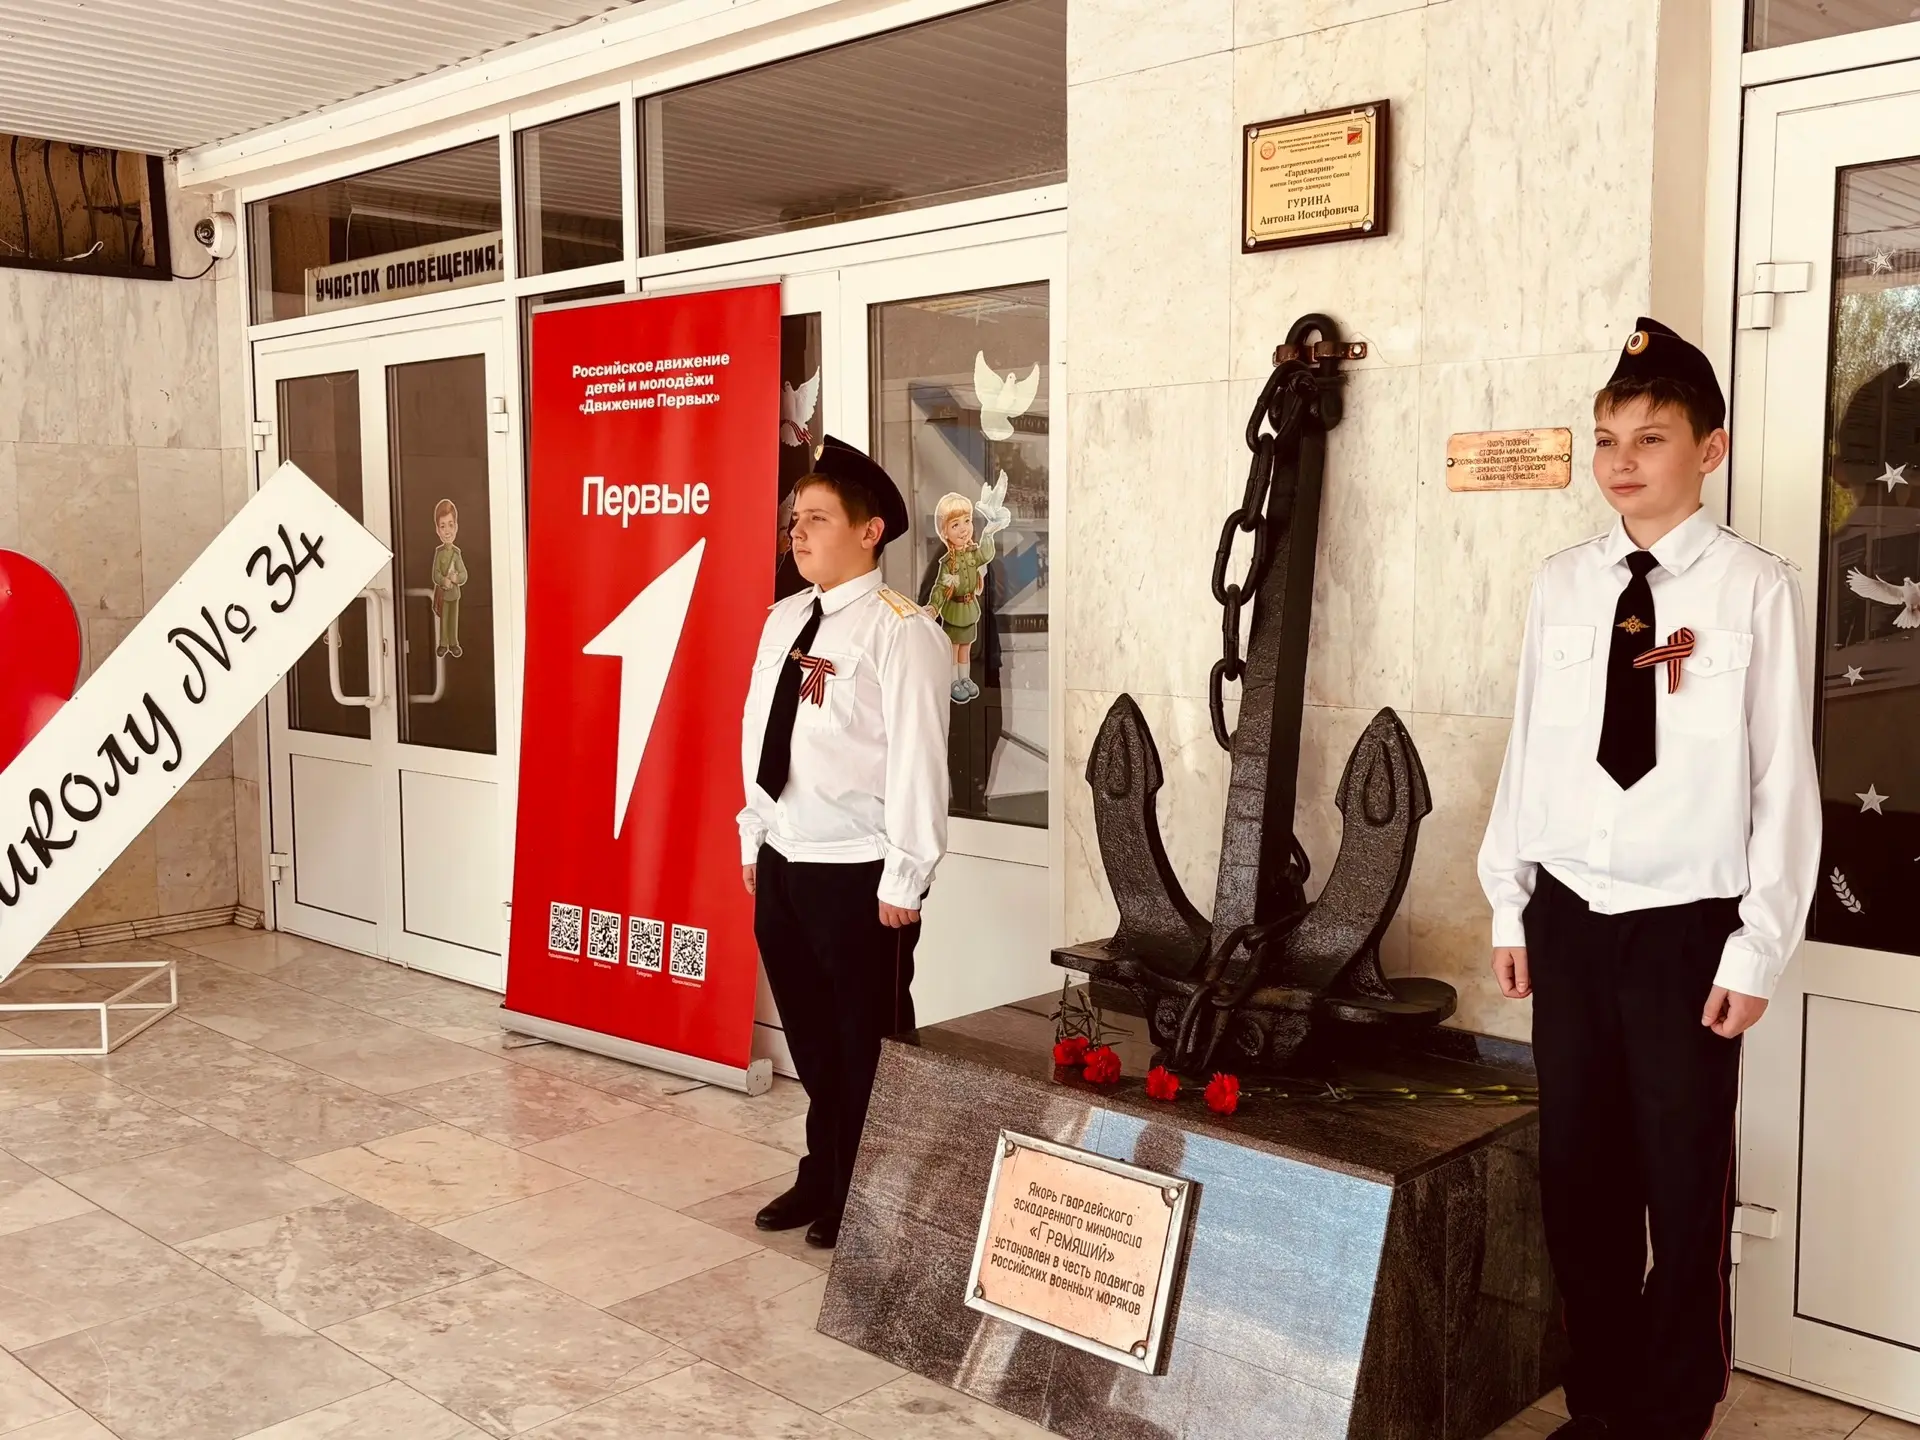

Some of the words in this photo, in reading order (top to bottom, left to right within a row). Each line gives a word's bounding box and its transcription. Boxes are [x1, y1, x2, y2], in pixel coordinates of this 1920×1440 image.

[1324, 152, 1347, 163] морской
[1348, 150, 1361, 159] клуб
[1284, 164, 1335, 178] «Гардемарин»
[1287, 178, 1302, 187] Героя
[1303, 173, 1332, 183] Советского
[1332, 171, 1350, 179] Союза
[1287, 194, 1331, 208] ГУРИНА
[1260, 210, 1295, 226] Антона
[1297, 205, 1359, 221] Иосифовича
[316, 267, 381, 302] УЧАСТОК
[386, 244, 496, 291] ОПОВЕЩЕНИЯ
[572, 360, 654, 379] Российское
[655, 353, 730, 373] движение
[585, 379, 626, 397] детей
[627, 381, 638, 392] и
[640, 372, 714, 391] молодёжи
[579, 395, 655, 415] «Движение
[657, 392, 720, 410] Первых»
[582, 476, 710, 529] Первые
[167, 605, 257, 705] №
[246, 524, 325, 614] 34
[1028, 1181, 1058, 1203] Якорь
[1060, 1193, 1133, 1226] гвардейского
[1013, 1197, 1083, 1230] эскадренного
[1085, 1220, 1143, 1249] миноносца
[994, 1236, 1051, 1266] установлен
[1052, 1256, 1060, 1268] в
[1062, 1259, 1092, 1279] честь
[1094, 1270, 1145, 1298] подвигов
[991, 1252, 1048, 1283] российских
[1049, 1273, 1094, 1300] военных
[1096, 1290, 1141, 1316] моряков
